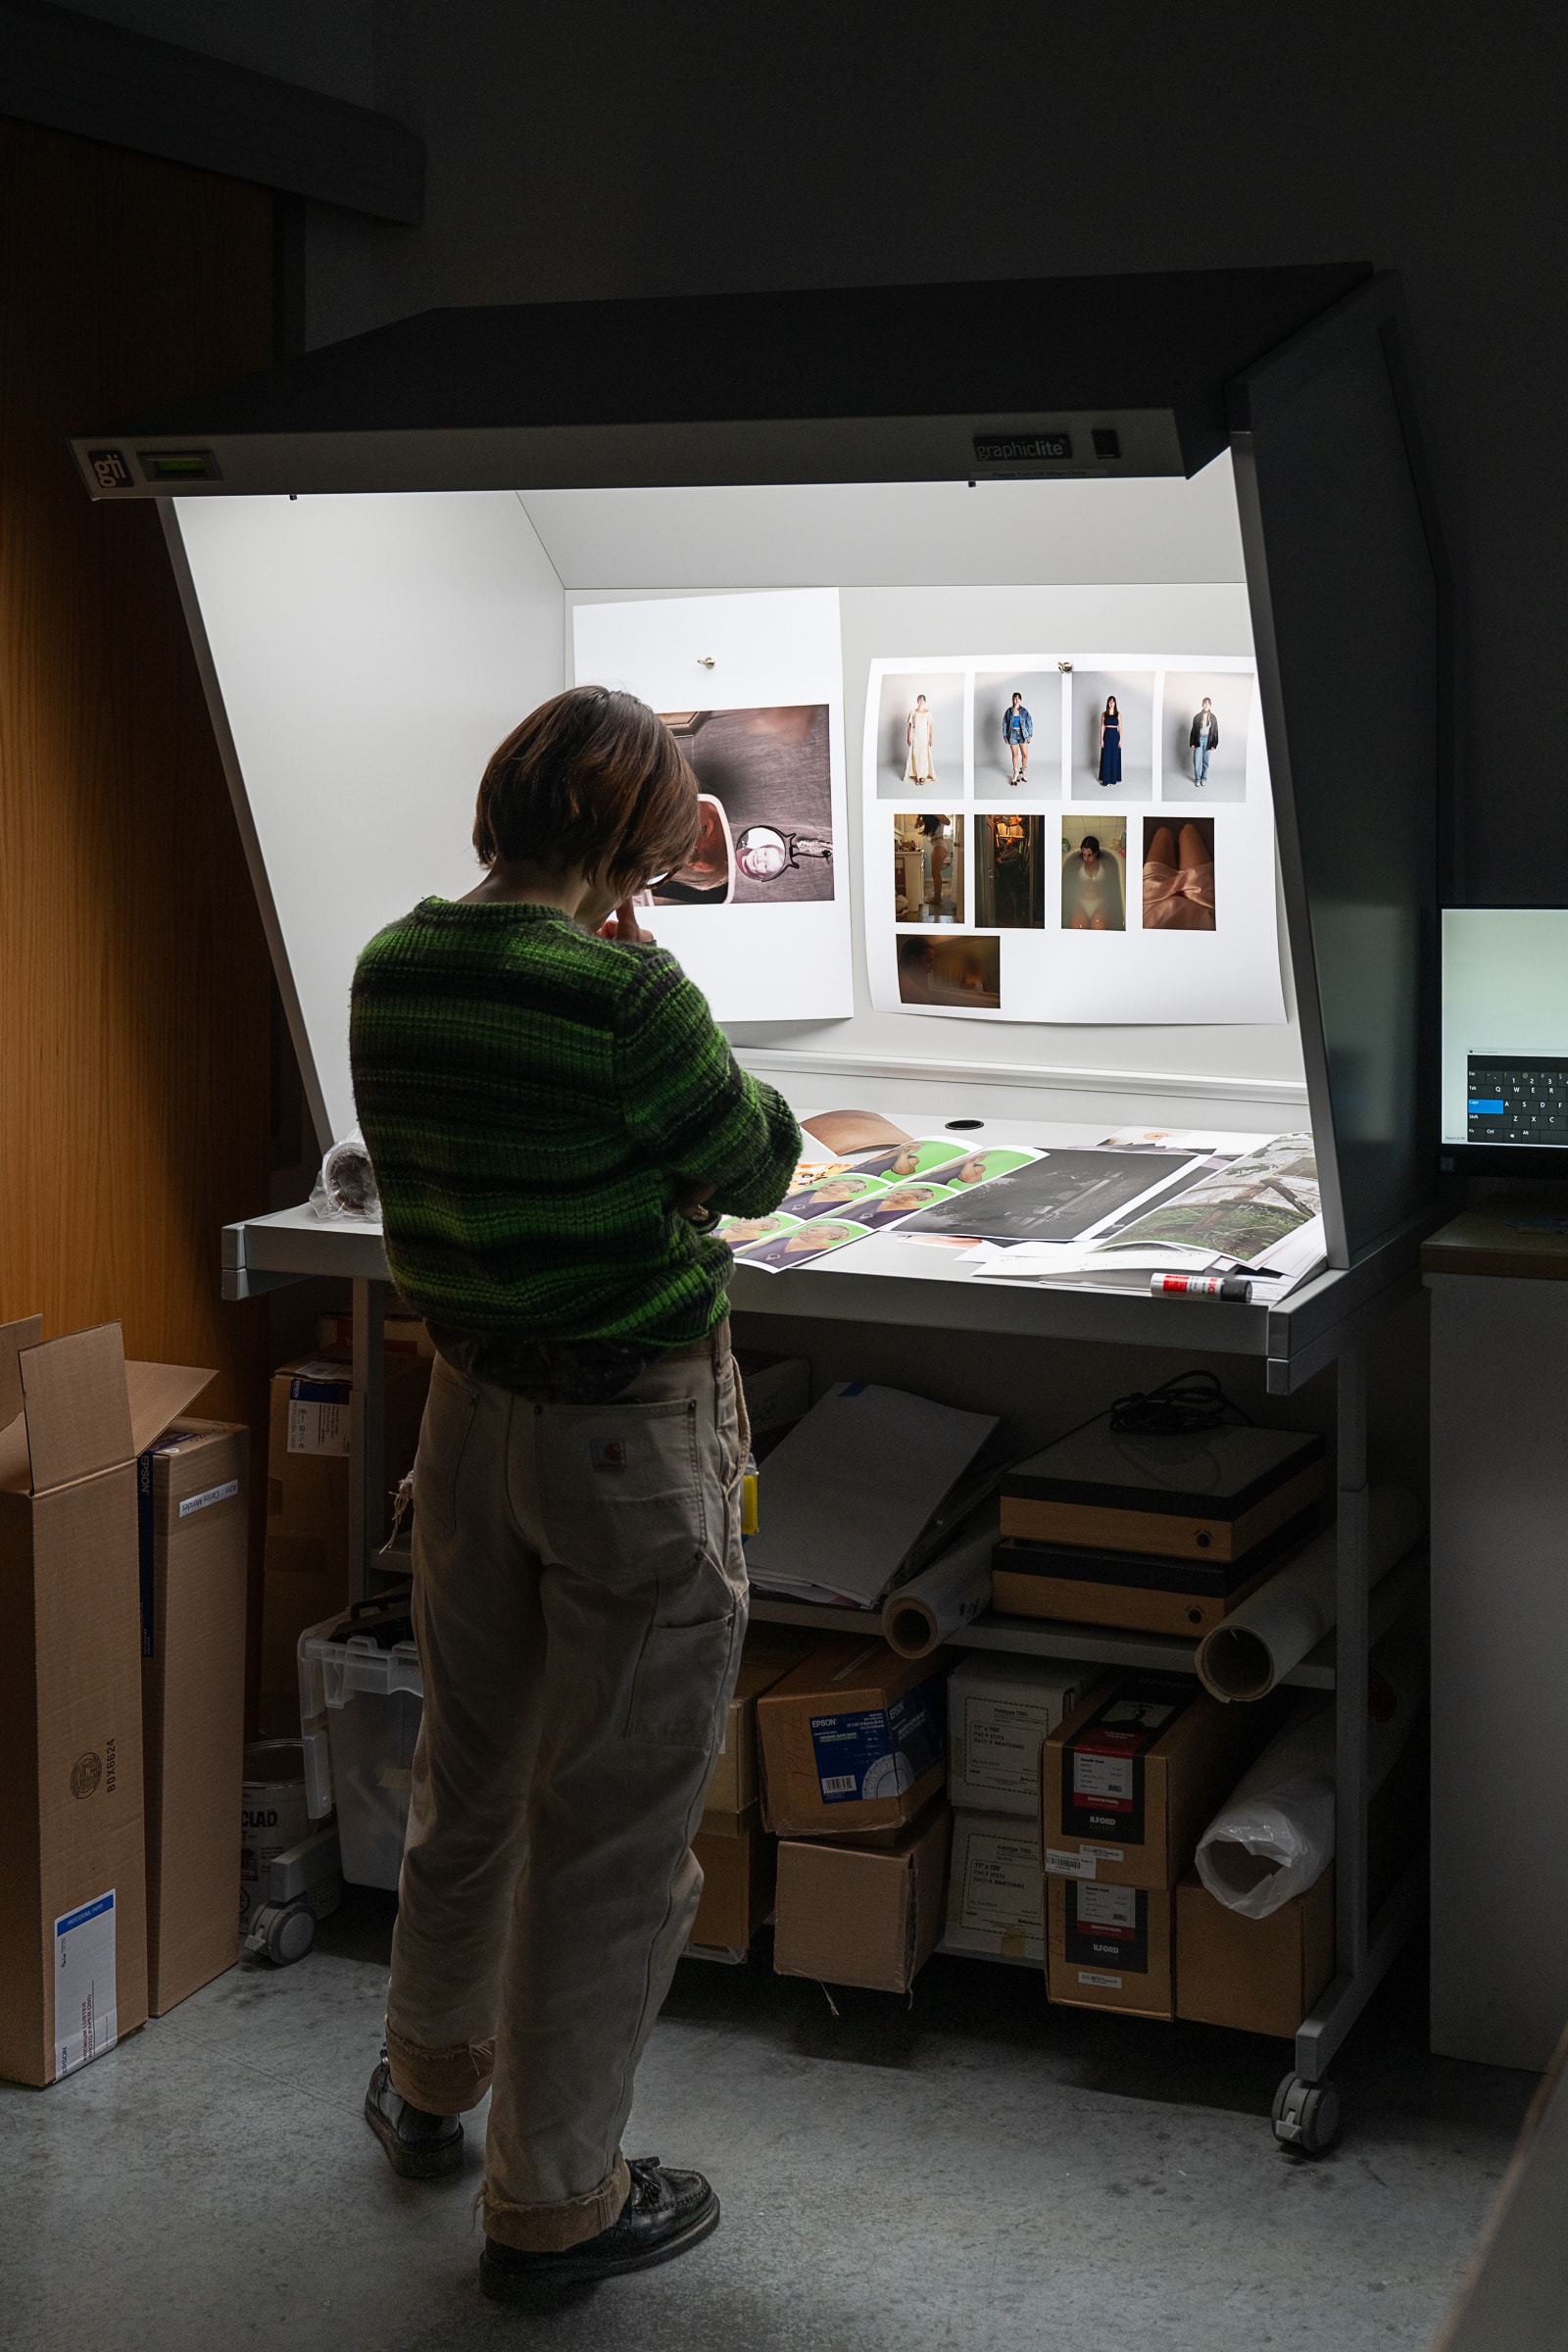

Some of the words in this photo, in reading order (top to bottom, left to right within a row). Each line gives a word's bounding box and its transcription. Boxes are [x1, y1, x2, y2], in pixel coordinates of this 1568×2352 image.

[811, 1718, 836, 1728] EPSON
[106, 1739, 116, 1792] BOX6624
[1090, 1815, 1116, 1826] ILFORD
[1093, 1943, 1119, 1954] ILFORD
